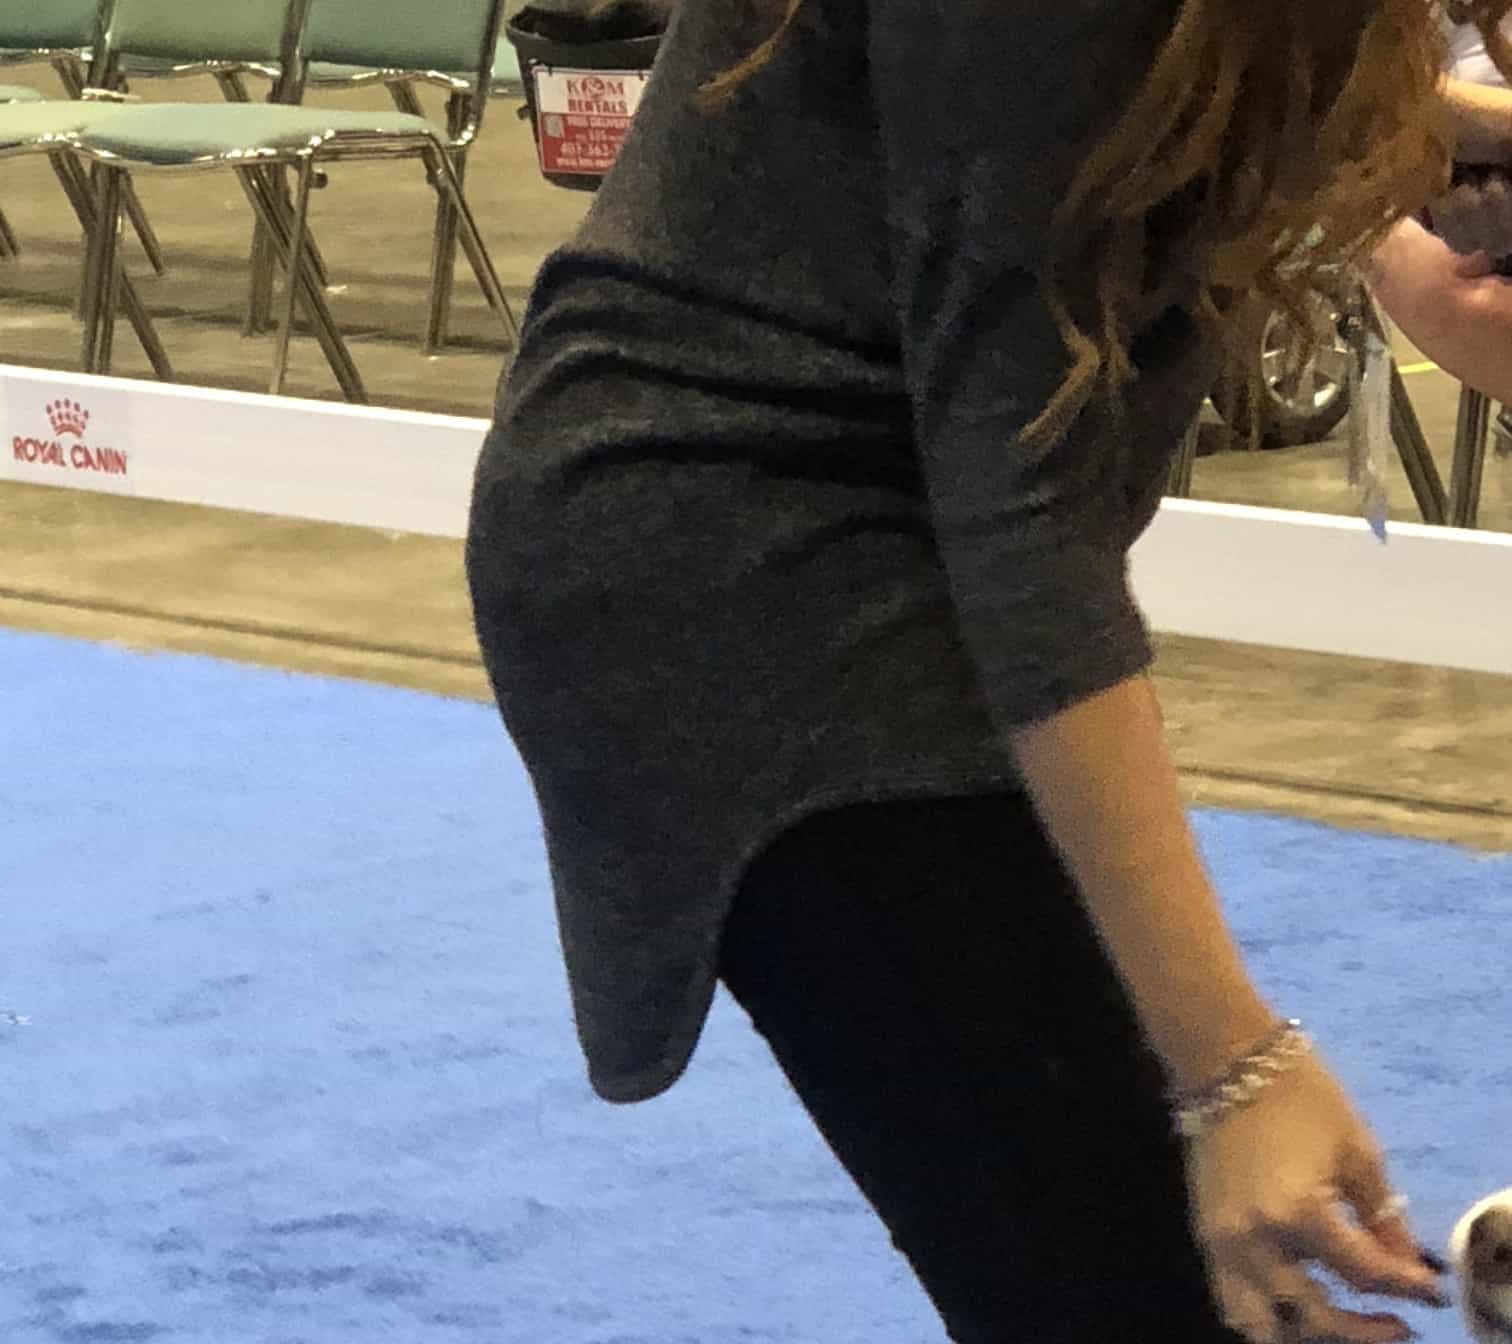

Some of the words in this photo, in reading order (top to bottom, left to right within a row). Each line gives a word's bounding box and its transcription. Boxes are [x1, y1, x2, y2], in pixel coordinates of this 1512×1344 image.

[568, 99, 627, 113] RENTALS
[12, 435, 66, 467] ROYAL
[70, 444, 127, 475] CANIN
